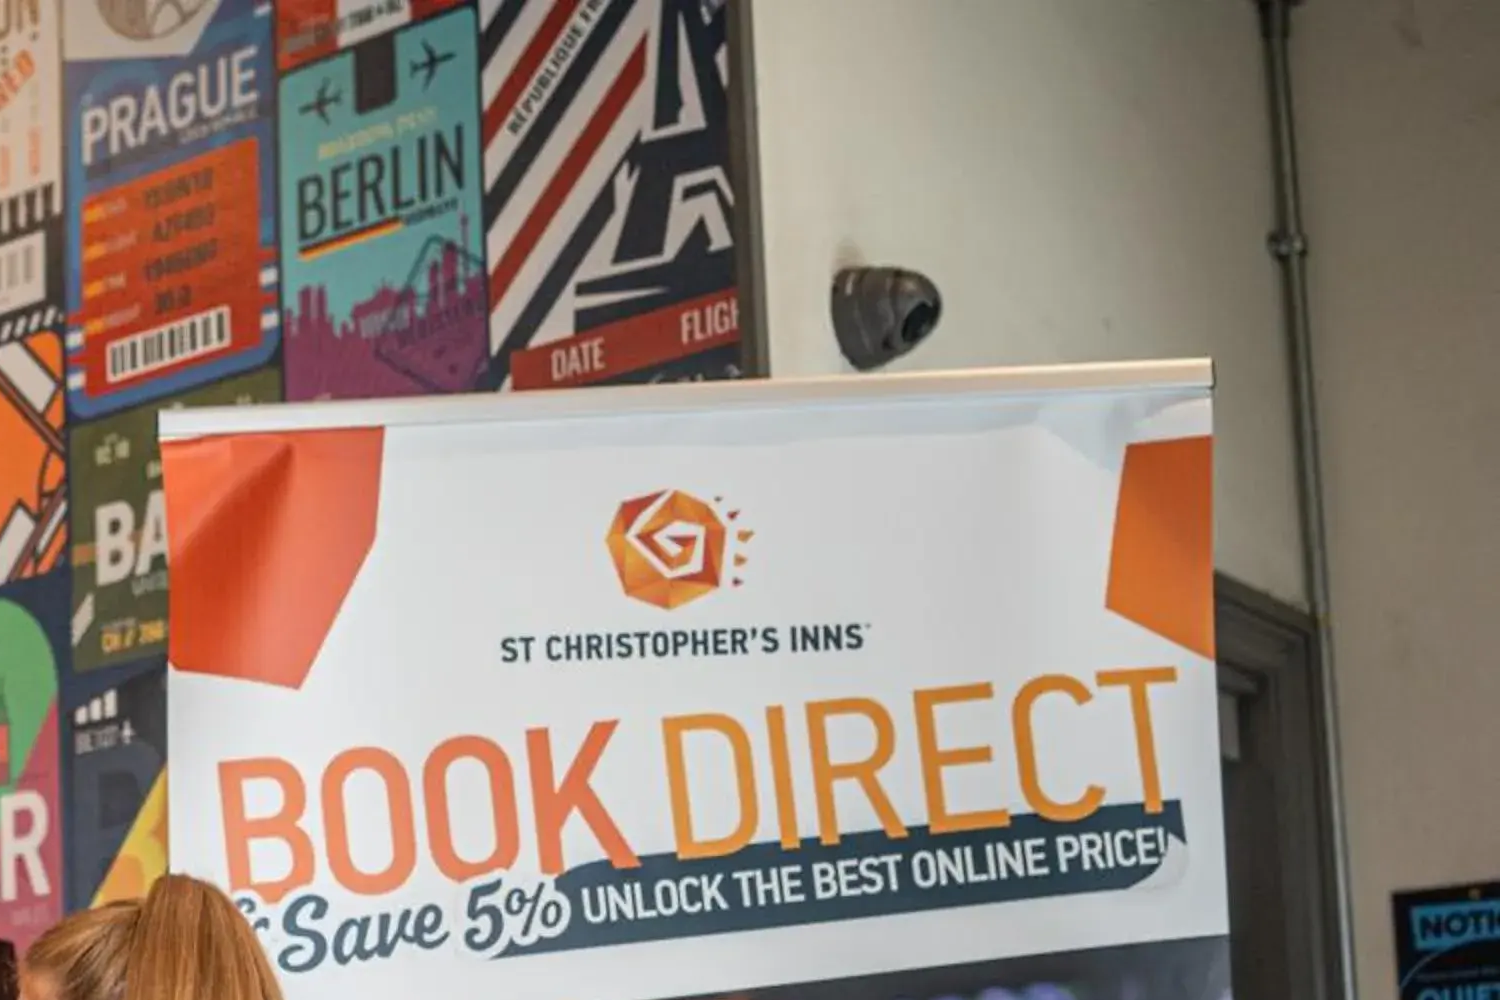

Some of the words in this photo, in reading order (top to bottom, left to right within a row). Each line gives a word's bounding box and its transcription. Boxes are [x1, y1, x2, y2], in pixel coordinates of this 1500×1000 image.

[82, 46, 260, 168] PRAGUE
[297, 122, 466, 242] BERLIN
[551, 336, 606, 381] DATE
[500, 636, 536, 664] ST
[545, 626, 780, 662] CHRISTOPHER'S
[217, 718, 642, 905] BOOK
[660, 666, 1179, 860] DIRECT
[277, 893, 450, 974] Save
[464, 876, 564, 952] 5%
[581, 876, 732, 924] UNLOCK
[733, 867, 806, 908] THE
[813, 854, 904, 901] BEST
[911, 838, 1050, 889] ONLINE
[1056, 826, 1167, 876] PRICE!
[1418, 905, 1500, 941] NOTI
